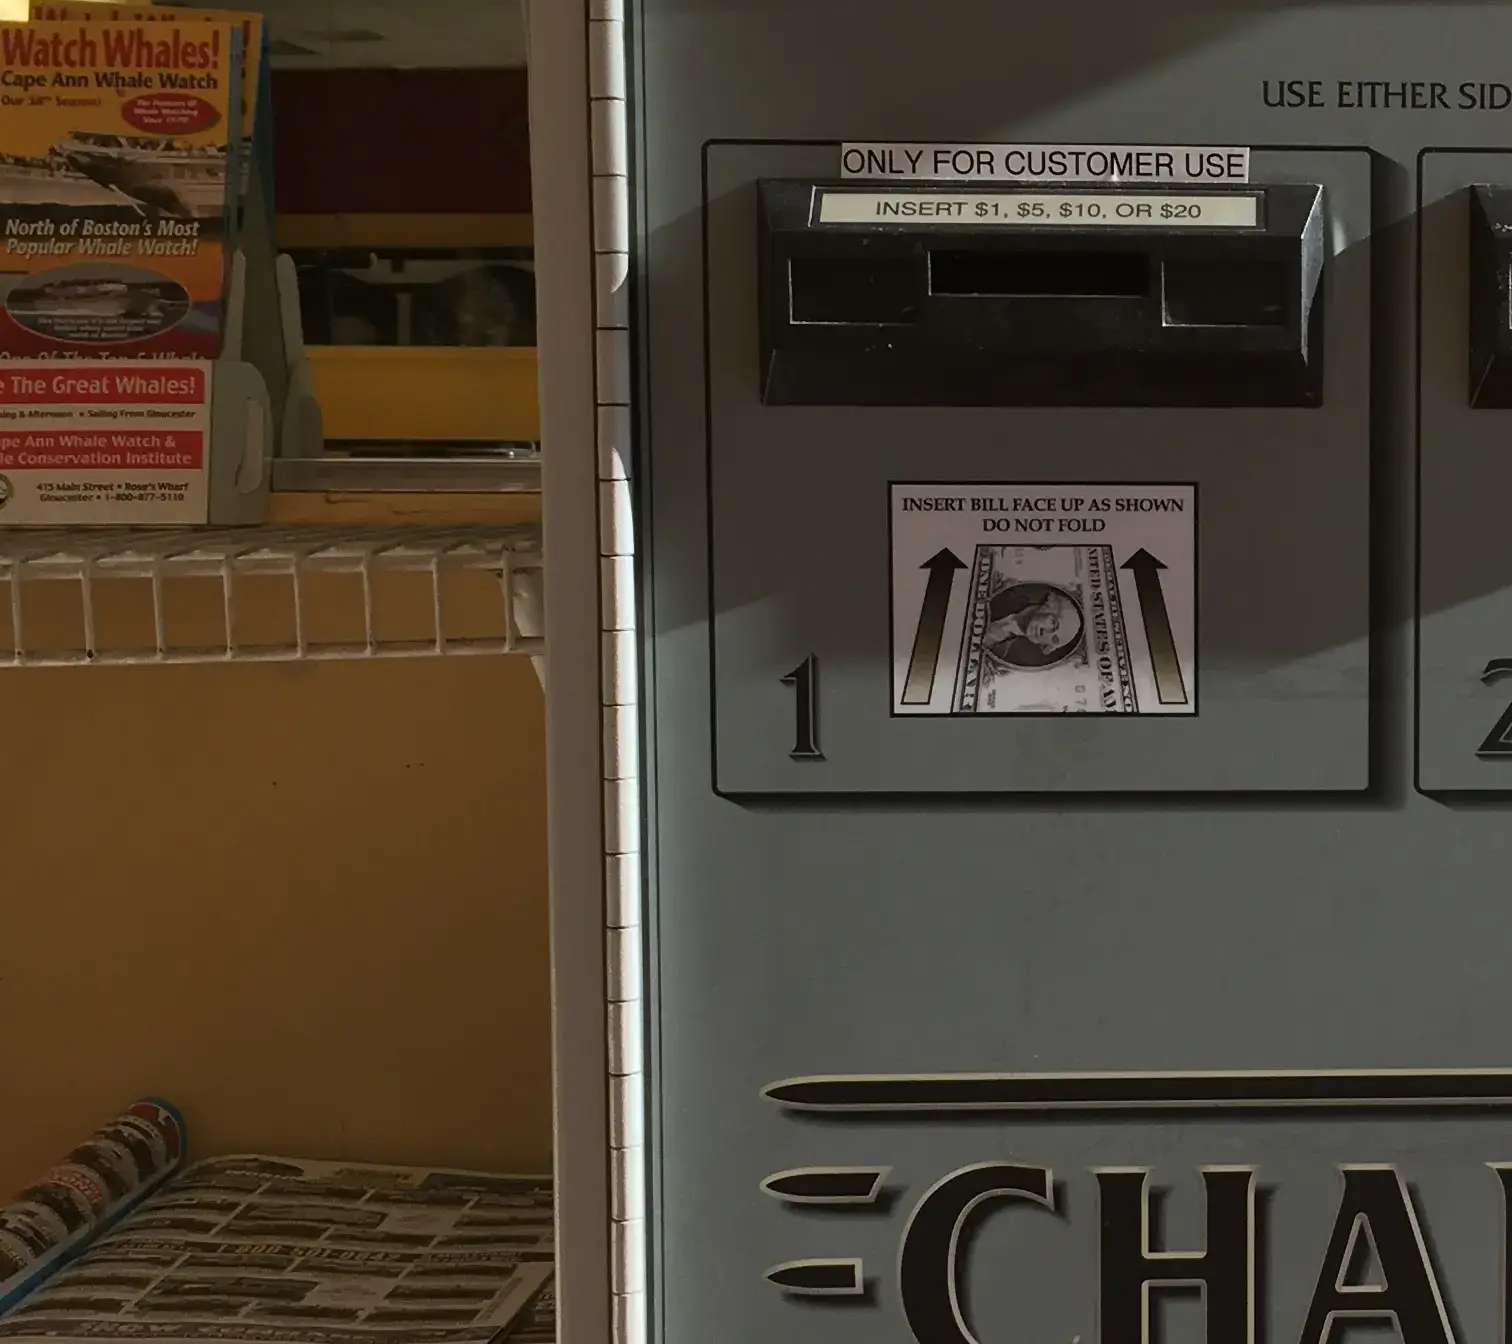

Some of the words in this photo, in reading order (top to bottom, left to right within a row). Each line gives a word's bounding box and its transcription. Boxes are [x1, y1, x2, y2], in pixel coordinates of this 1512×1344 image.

[2, 27, 97, 68] Watch
[102, 27, 219, 69] Whales!
[1, 70, 47, 91] Cape
[52, 72, 89, 87] Ann
[93, 71, 153, 88] Whale
[158, 72, 218, 89] Watch
[1263, 80, 1324, 108] USE
[1338, 81, 1450, 110] EITHER
[844, 148, 923, 175] ONLY
[934, 150, 996, 176] FOR
[1005, 151, 1174, 178] CUSTOMER
[1186, 153, 1245, 179] USE
[876, 202, 967, 216] INSERT
[974, 201, 1009, 219] $1,
[1017, 201, 1051, 219] $5,
[1059, 202, 1106, 220] $10,
[1116, 203, 1153, 218] OR
[1160, 203, 1202, 220] $20
[5, 219, 54, 236] North
[59, 219, 79, 236] of
[82, 219, 152, 236] Boston's
[157, 220, 200, 236] Most
[7, 238, 76, 259] Popular
[78, 238, 132, 256] Whale
[138, 239, 198, 256] Watch!
[11, 376, 46, 394] The
[53, 376, 109, 394] Great
[115, 376, 196, 394] Whales!
[0, 437, 20, 449] pe
[25, 435, 54, 447] Ann
[60, 435, 107, 447] Whale
[111, 435, 160, 447] Watch
[165, 435, 176, 447] &
[18, 452, 121, 464] Conservation
[126, 452, 192, 464] Institute
[902, 498, 966, 512] INSERT
[970, 498, 1009, 512] BILL
[1012, 498, 1056, 512] FACE
[1060, 498, 1084, 512] UP
[1087, 498, 1111, 512] AS
[1115, 498, 1184, 513] SHOWN
[983, 518, 1011, 532] DO
[1014, 518, 1055, 532] NOT
[1058, 518, 1106, 532] FOLD
[1087, 547, 1102, 592] NITED
[780, 652, 826, 761] 1
